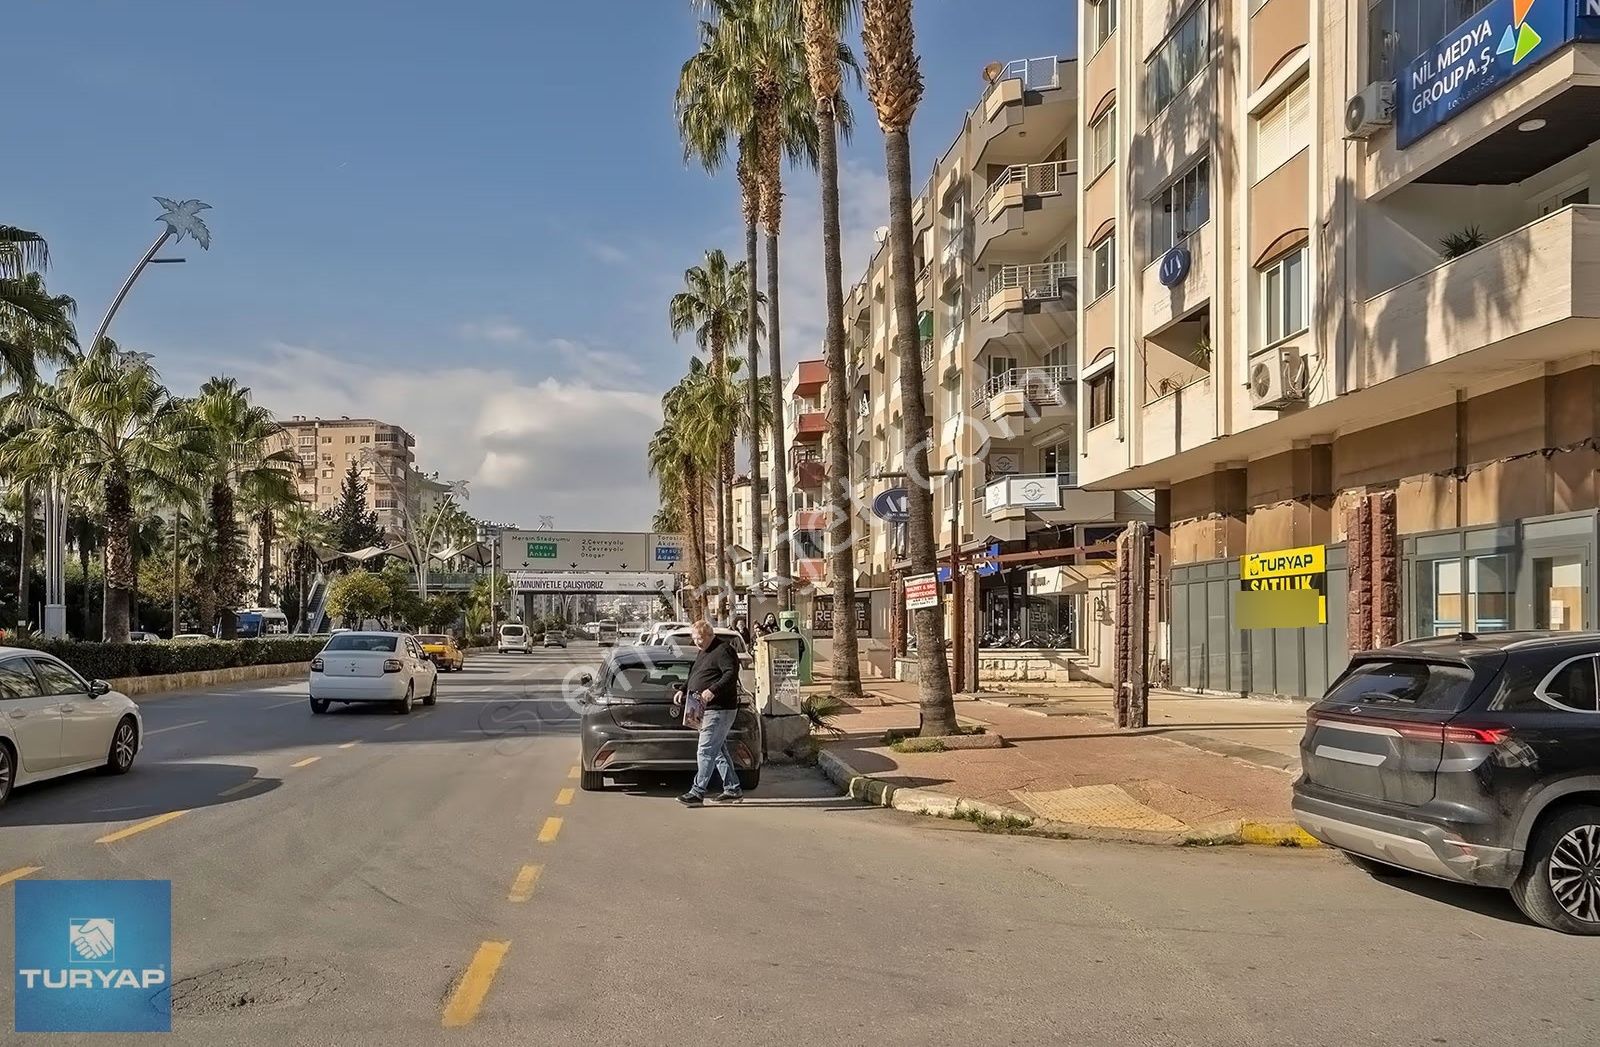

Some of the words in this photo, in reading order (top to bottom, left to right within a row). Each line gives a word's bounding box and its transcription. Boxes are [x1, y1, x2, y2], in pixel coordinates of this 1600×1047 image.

[1412, 60, 1436, 90] NİL
[1437, 20, 1493, 73] MEDYA
[1259, 554, 1313, 572] TURYAP
[563, 580, 604, 590] ÇALIŞIYORUZ
